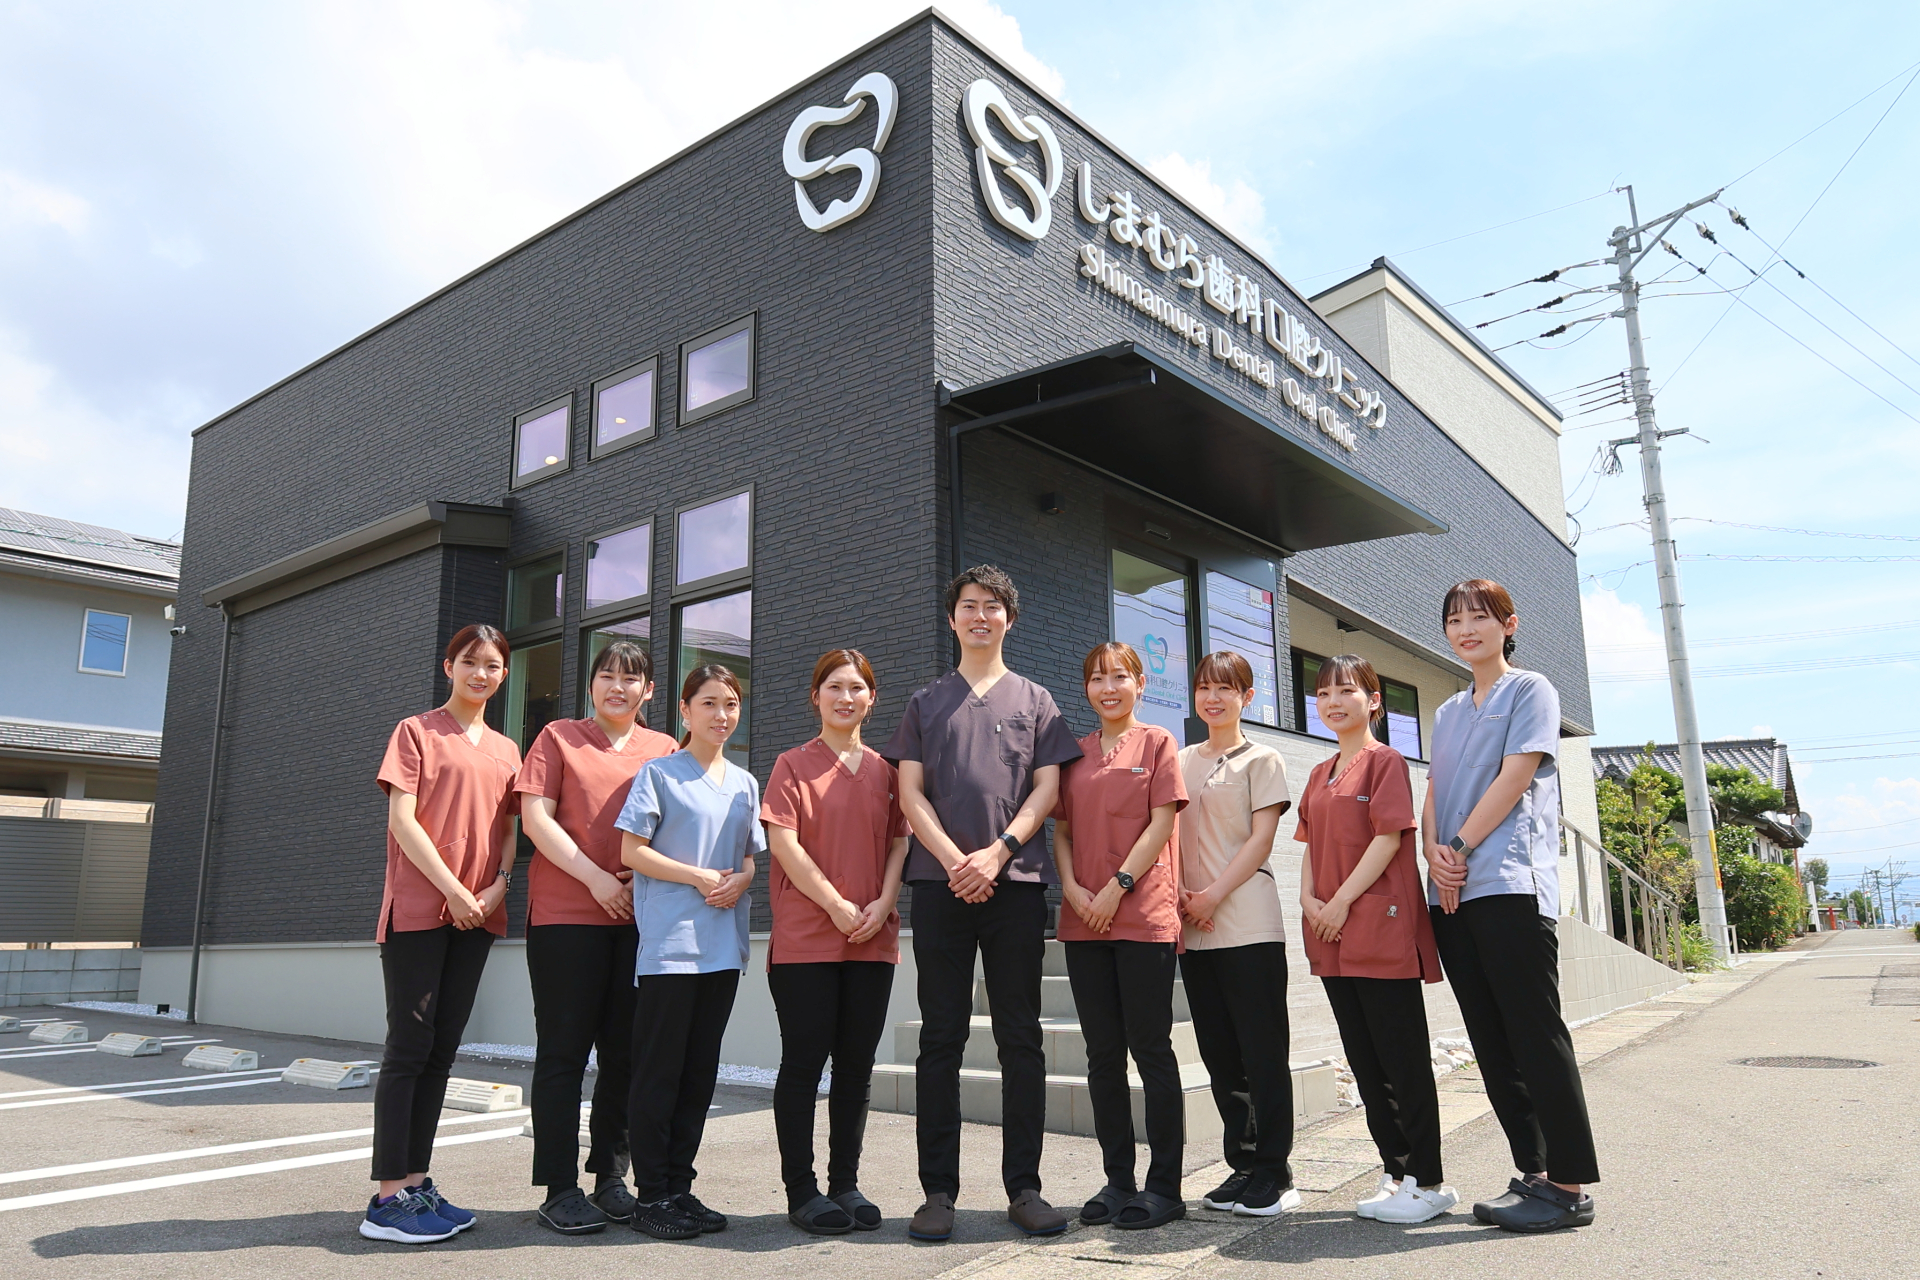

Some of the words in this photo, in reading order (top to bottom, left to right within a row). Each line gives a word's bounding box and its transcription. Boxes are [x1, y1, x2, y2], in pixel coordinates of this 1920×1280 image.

[1077, 161, 1387, 429] しまむら歯科口腔クリニック
[1080, 244, 1208, 346] Shimamura
[1212, 327, 1275, 388] Dental
[1283, 377, 1317, 420] Oral
[1319, 406, 1358, 451] Clinic
